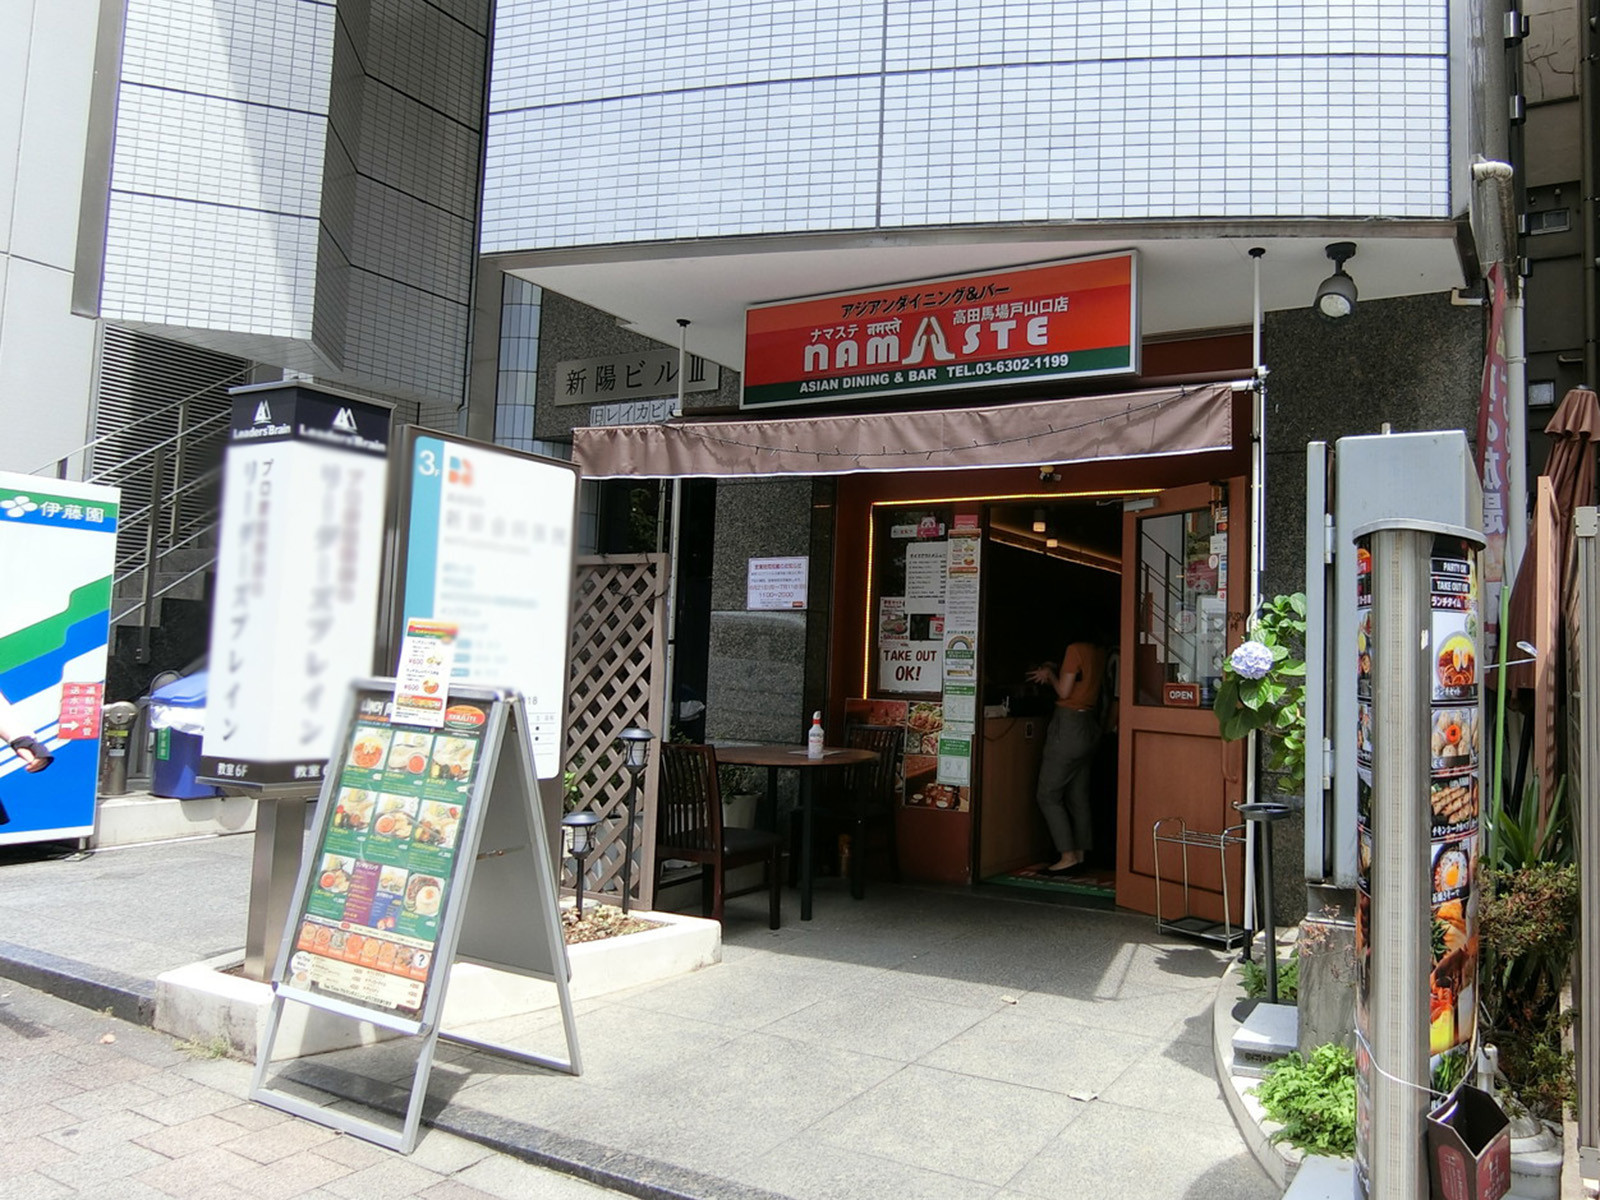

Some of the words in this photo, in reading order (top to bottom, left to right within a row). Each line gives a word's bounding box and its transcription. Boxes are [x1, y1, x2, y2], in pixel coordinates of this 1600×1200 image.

[841, 286, 1010, 318] アジアンダイニング&バー
[953, 296, 1069, 326] 高田馬場戸山口店
[810, 324, 859, 342] ナマステ
[799, 379, 839, 393] ASIAN
[843, 374, 889, 389] DINING
[894, 372, 903, 383] &
[908, 368, 937, 381] BAR
[947, 354, 1069, 378] TEL.03-6302-1199
[40, 501, 104, 523] 伊藤園
[1437, 581, 1451, 591] TAKE
[1452, 582, 1462, 591] OUT
[1431, 595, 1462, 607] ランチタイム
[884, 651, 911, 662] TAKE
[916, 651, 937, 662] OUT
[895, 666, 921, 681] OK!
[1169, 690, 1194, 700] OPEN
